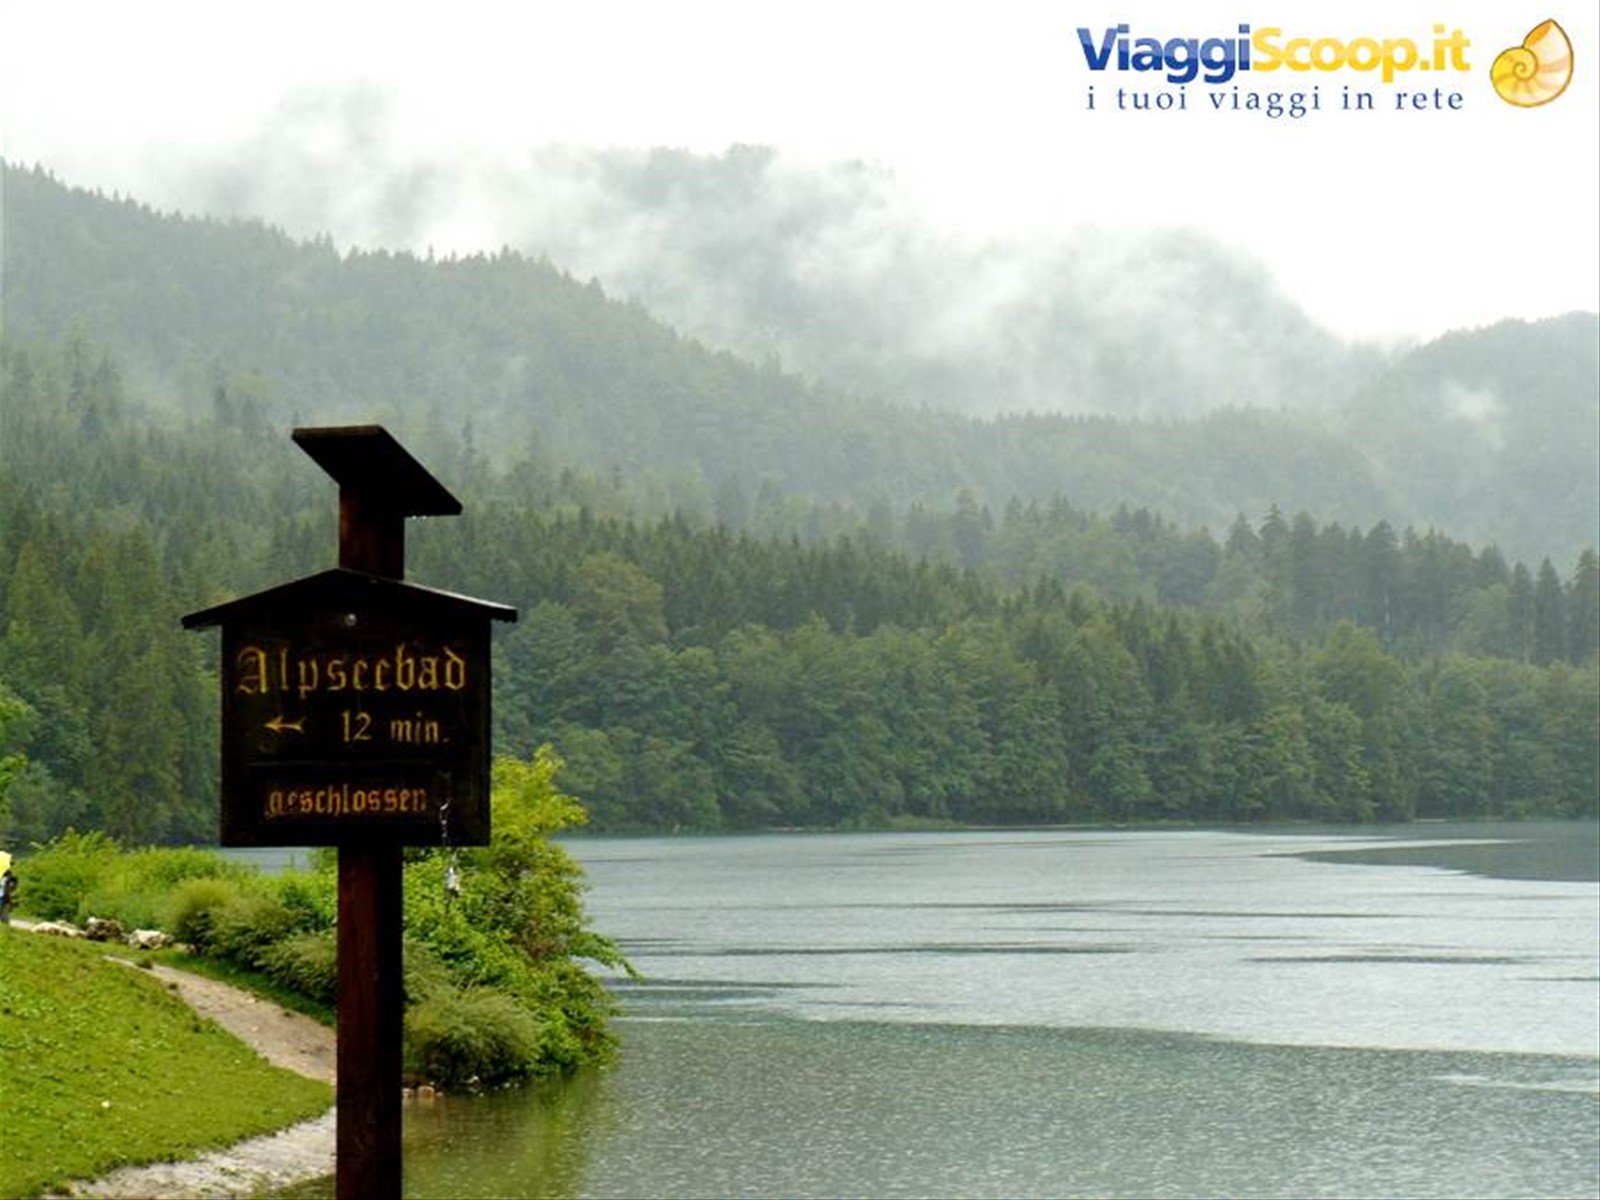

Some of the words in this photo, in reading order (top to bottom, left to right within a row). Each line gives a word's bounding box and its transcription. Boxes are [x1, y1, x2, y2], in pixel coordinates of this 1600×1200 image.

[236, 643, 466, 698] Alpseebad
[341, 710, 373, 742] 12
[390, 711, 449, 743] min.
[264, 783, 427, 818] geschlossen
